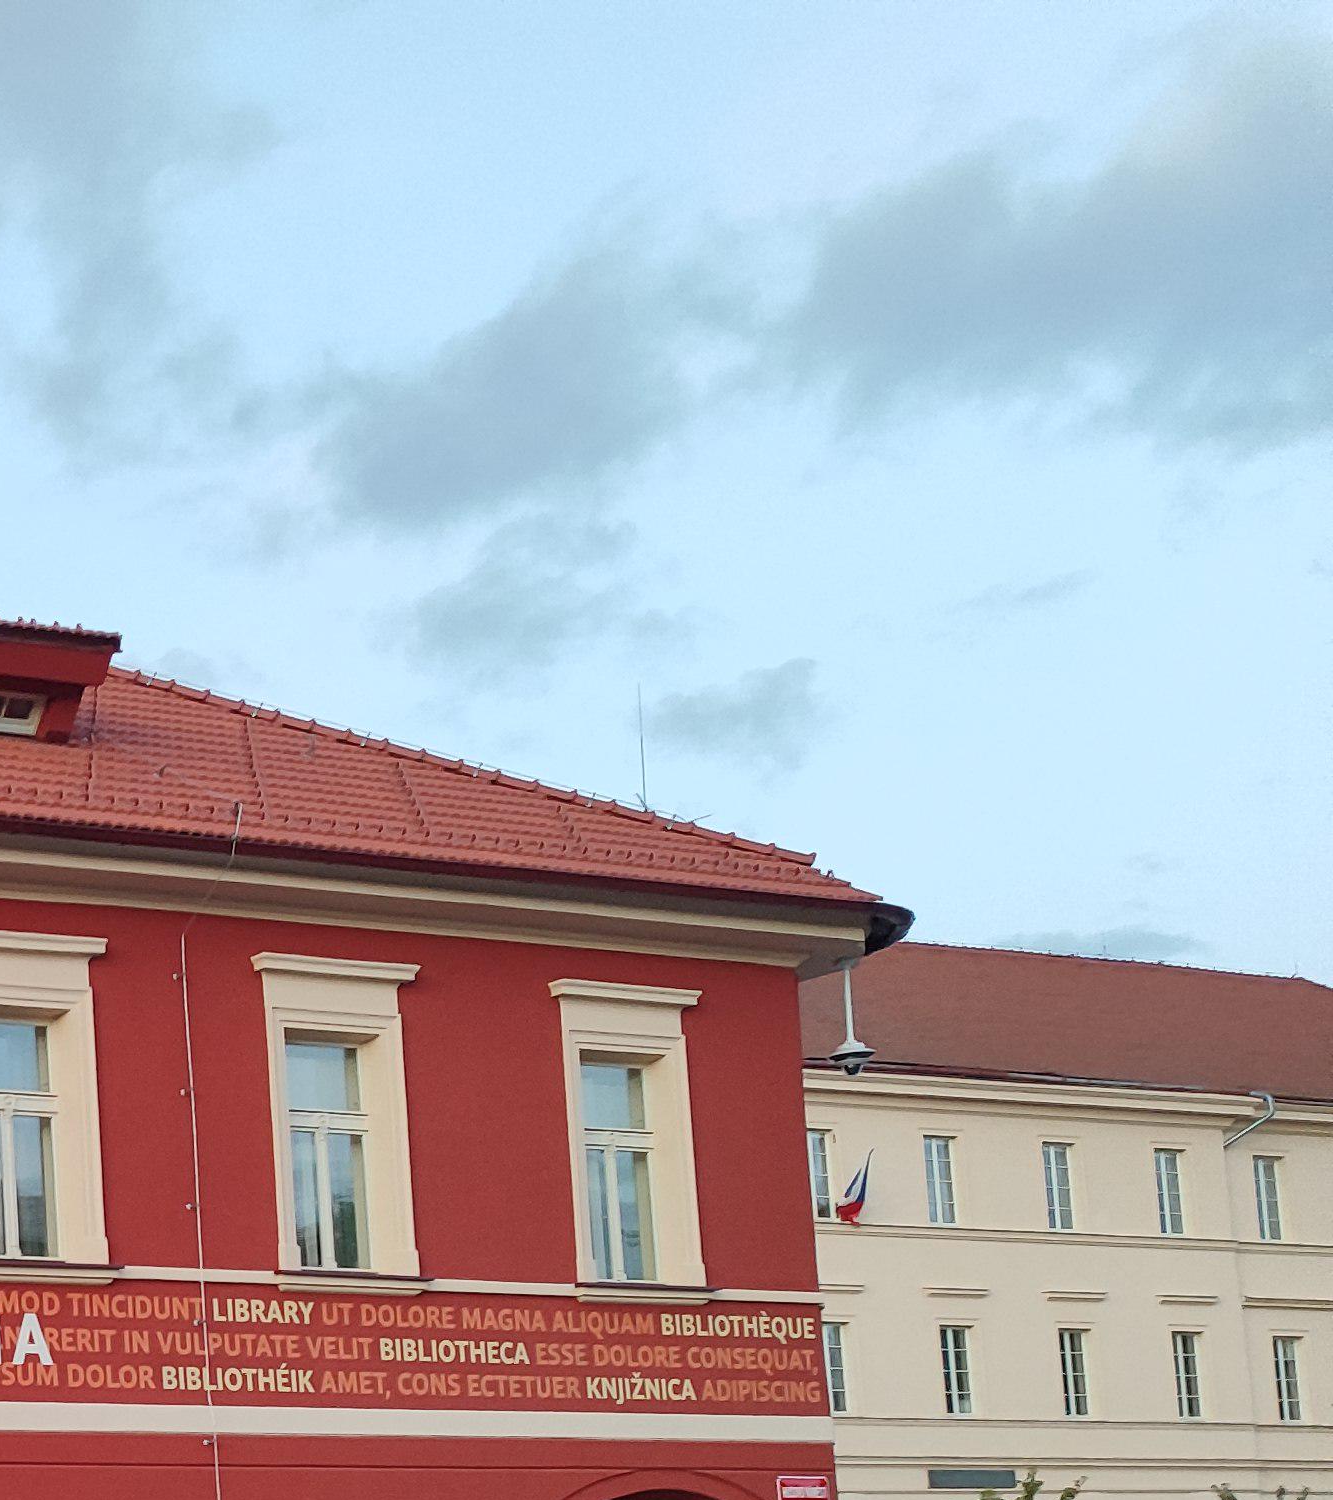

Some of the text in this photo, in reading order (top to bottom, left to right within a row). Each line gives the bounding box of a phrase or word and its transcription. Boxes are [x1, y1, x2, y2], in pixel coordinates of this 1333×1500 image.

[67, 1293, 202, 1320] TINCIDUNT
[212, 1298, 314, 1324] LIBRARY
[322, 1302, 353, 1325] UT
[361, 1304, 456, 1329] DOLORE
[462, 1307, 546, 1331] MAGNA
[553, 1311, 655, 1338] ALIQUAM
[660, 1311, 816, 1342] BIBLIOTHÈQUE
[124, 1330, 150, 1353] IN
[157, 1331, 301, 1358] VULPUTATE
[306, 1336, 372, 1360] VELIT
[380, 1338, 530, 1364] BIBLIOTHECA
[535, 1343, 588, 1366] ESSE
[593, 1345, 684, 1368] DOLORE
[688, 1347, 819, 1375] CONSEQUAT,
[67, 1364, 155, 1389] DOLOR
[162, 1363, 315, 1393] BIBLIOTHÉIK
[321, 1371, 392, 1399] AMET,
[398, 1372, 460, 1396] CONS
[467, 1375, 581, 1399] ECTETUER
[586, 1373, 697, 1404] KNJIŽNICA
[702, 1380, 821, 1403] ADIPISCING
